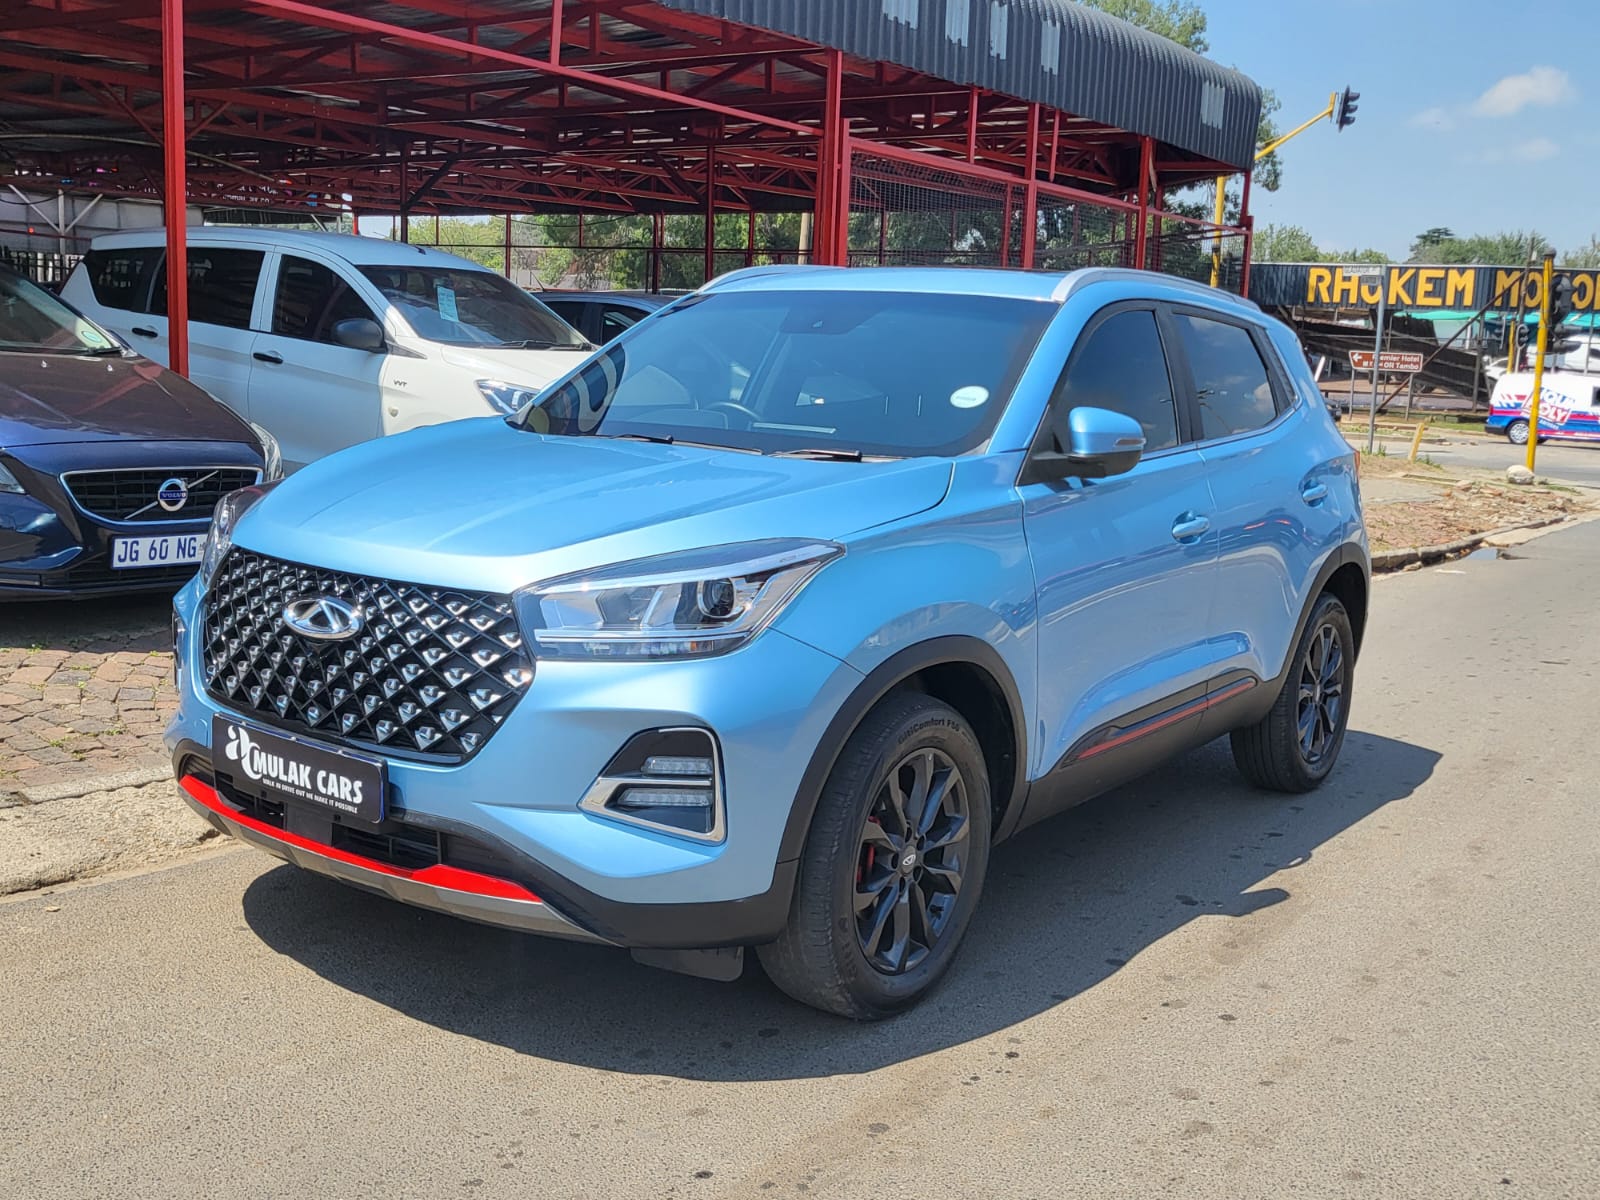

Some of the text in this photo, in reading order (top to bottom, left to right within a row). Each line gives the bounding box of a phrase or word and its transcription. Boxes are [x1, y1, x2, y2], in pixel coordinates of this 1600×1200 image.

[1494, 270, 1600, 310] MOO
[1396, 362, 1419, 370] Tambo
[393, 379, 408, 388] VVT
[1528, 401, 1569, 422] OLY
[117, 537, 197, 562] JG 60 NG
[316, 769, 363, 804] CARS
